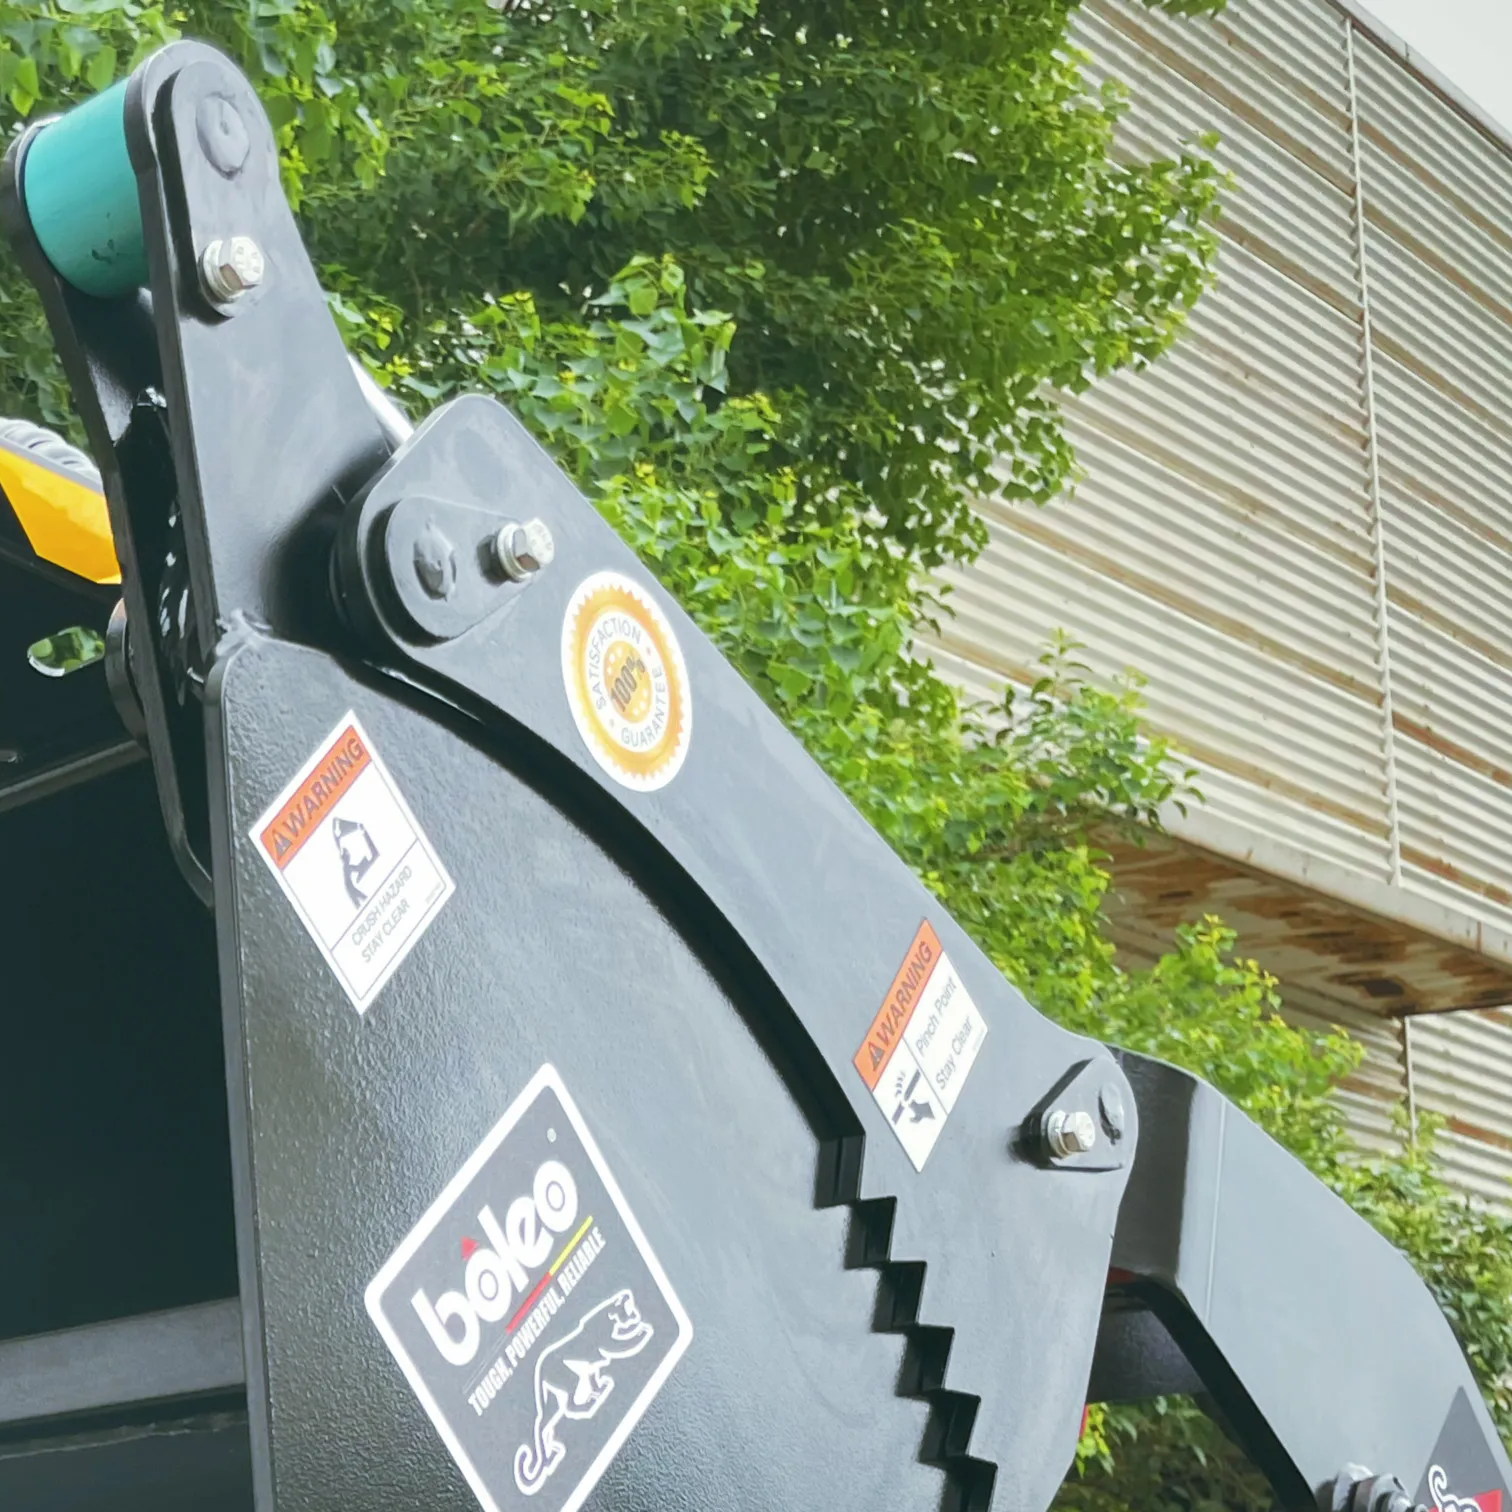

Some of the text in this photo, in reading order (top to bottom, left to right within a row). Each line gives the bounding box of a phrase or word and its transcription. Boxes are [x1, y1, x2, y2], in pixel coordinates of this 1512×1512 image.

[588, 616, 642, 711] SATISFACTION
[611, 651, 646, 713] 100%
[621, 667, 666, 748] GUARANTEE
[286, 737, 364, 838] WARNING
[351, 865, 413, 946] CRUSH HAZARD
[361, 898, 411, 963] STAY CLEAR
[876, 941, 932, 1046] WARNING
[915, 976, 957, 1056] Pinch Point
[934, 1015, 974, 1091] Stay Clear
[557, 1226, 606, 1296] RELIABLE
